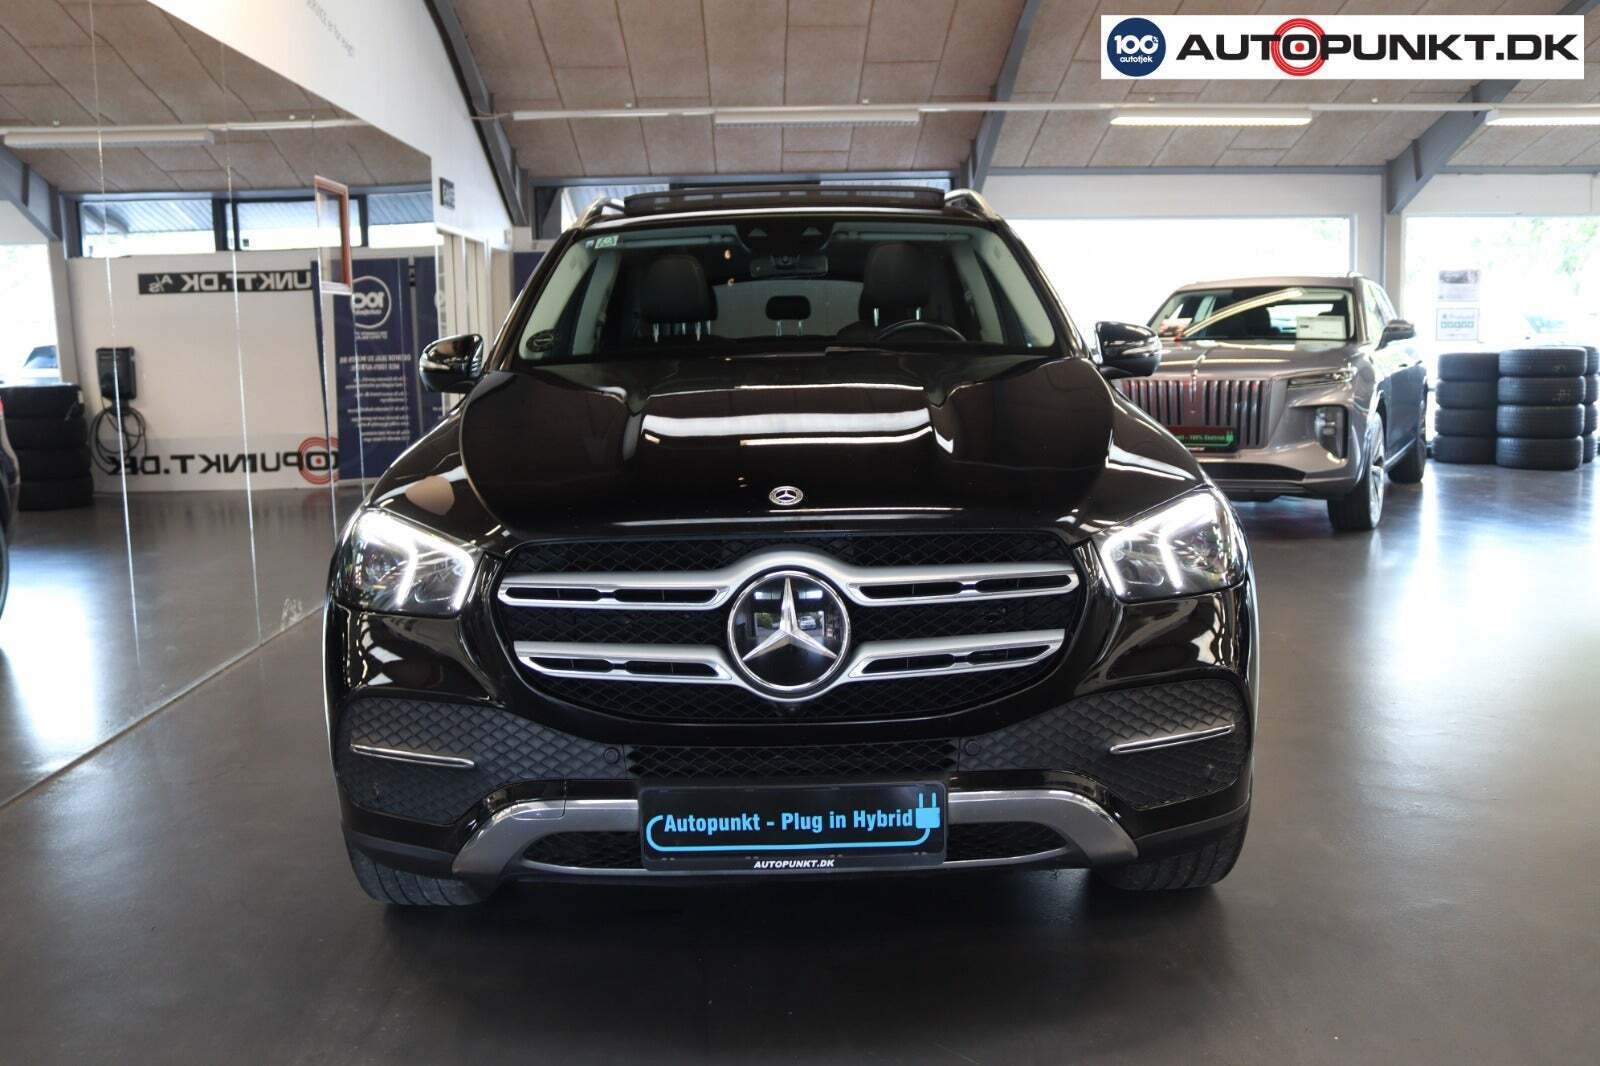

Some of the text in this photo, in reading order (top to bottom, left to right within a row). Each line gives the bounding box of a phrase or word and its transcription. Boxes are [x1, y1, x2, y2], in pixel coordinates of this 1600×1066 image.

[664, 812, 760, 835] Autopunkt
[781, 811, 823, 833] Plug
[829, 810, 847, 830] in
[853, 808, 913, 831] Hybrid
[753, 858, 835, 870] AUTOPUNKT.DK
